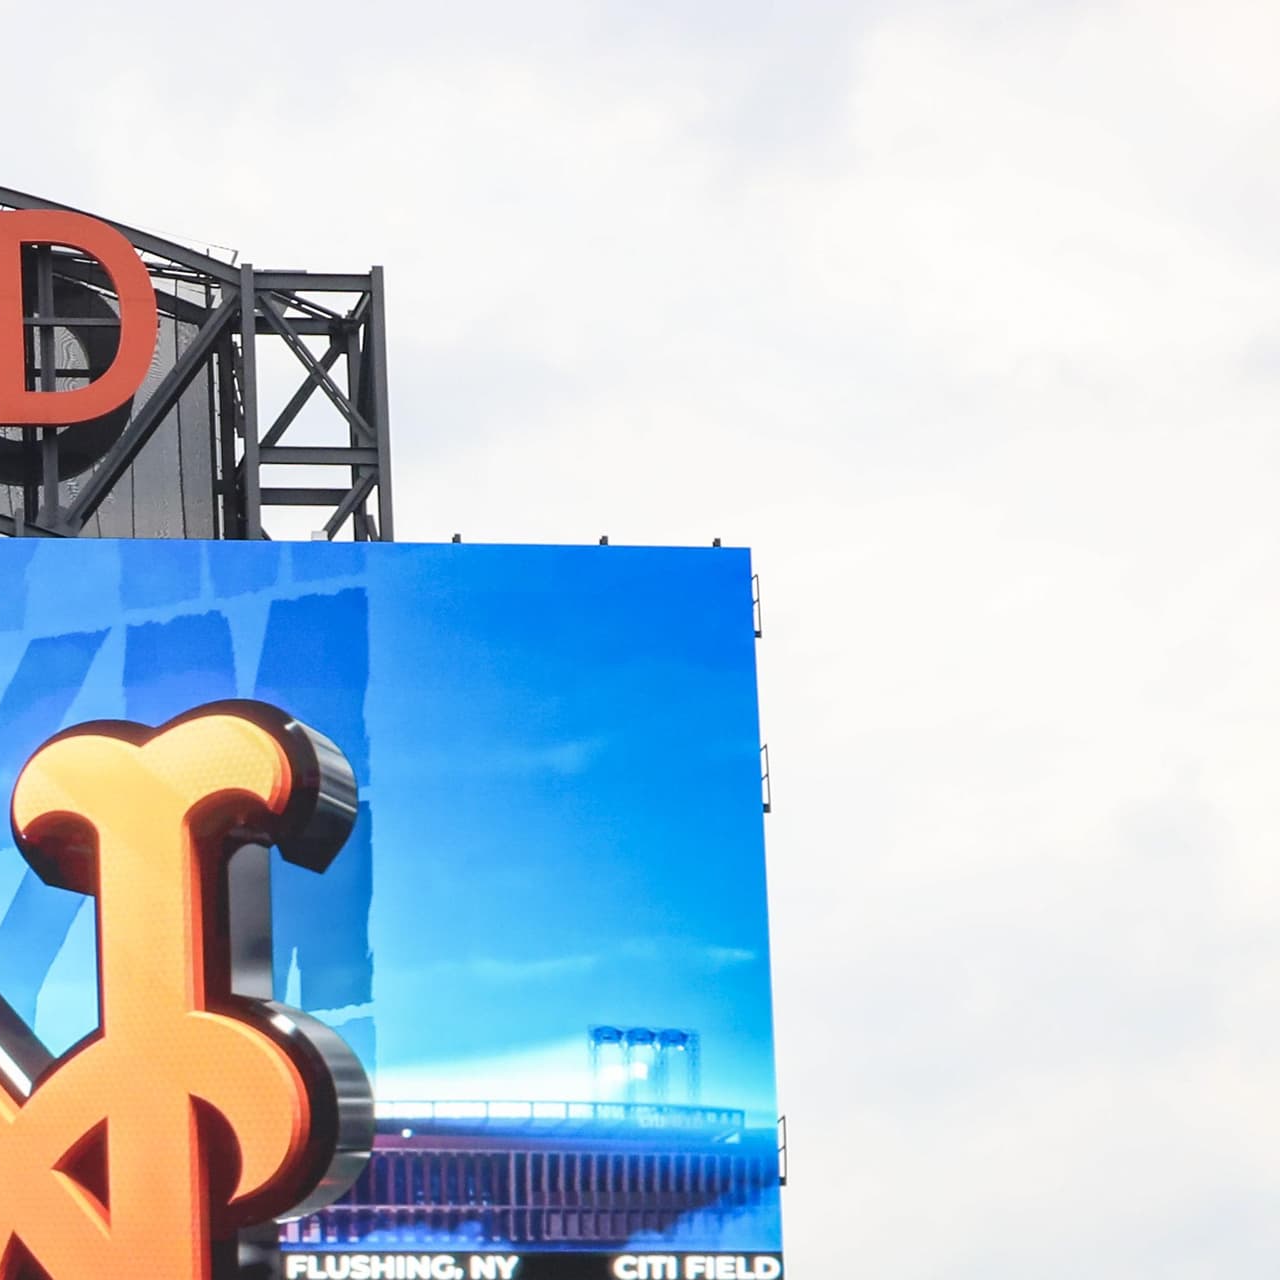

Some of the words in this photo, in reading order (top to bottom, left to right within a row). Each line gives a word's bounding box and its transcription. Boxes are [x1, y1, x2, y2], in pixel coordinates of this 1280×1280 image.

[286, 1255, 465, 1280] FLUSHING,
[471, 1255, 520, 1280] NY
[612, 1255, 677, 1280] CITI
[686, 1255, 781, 1280] FIELD
